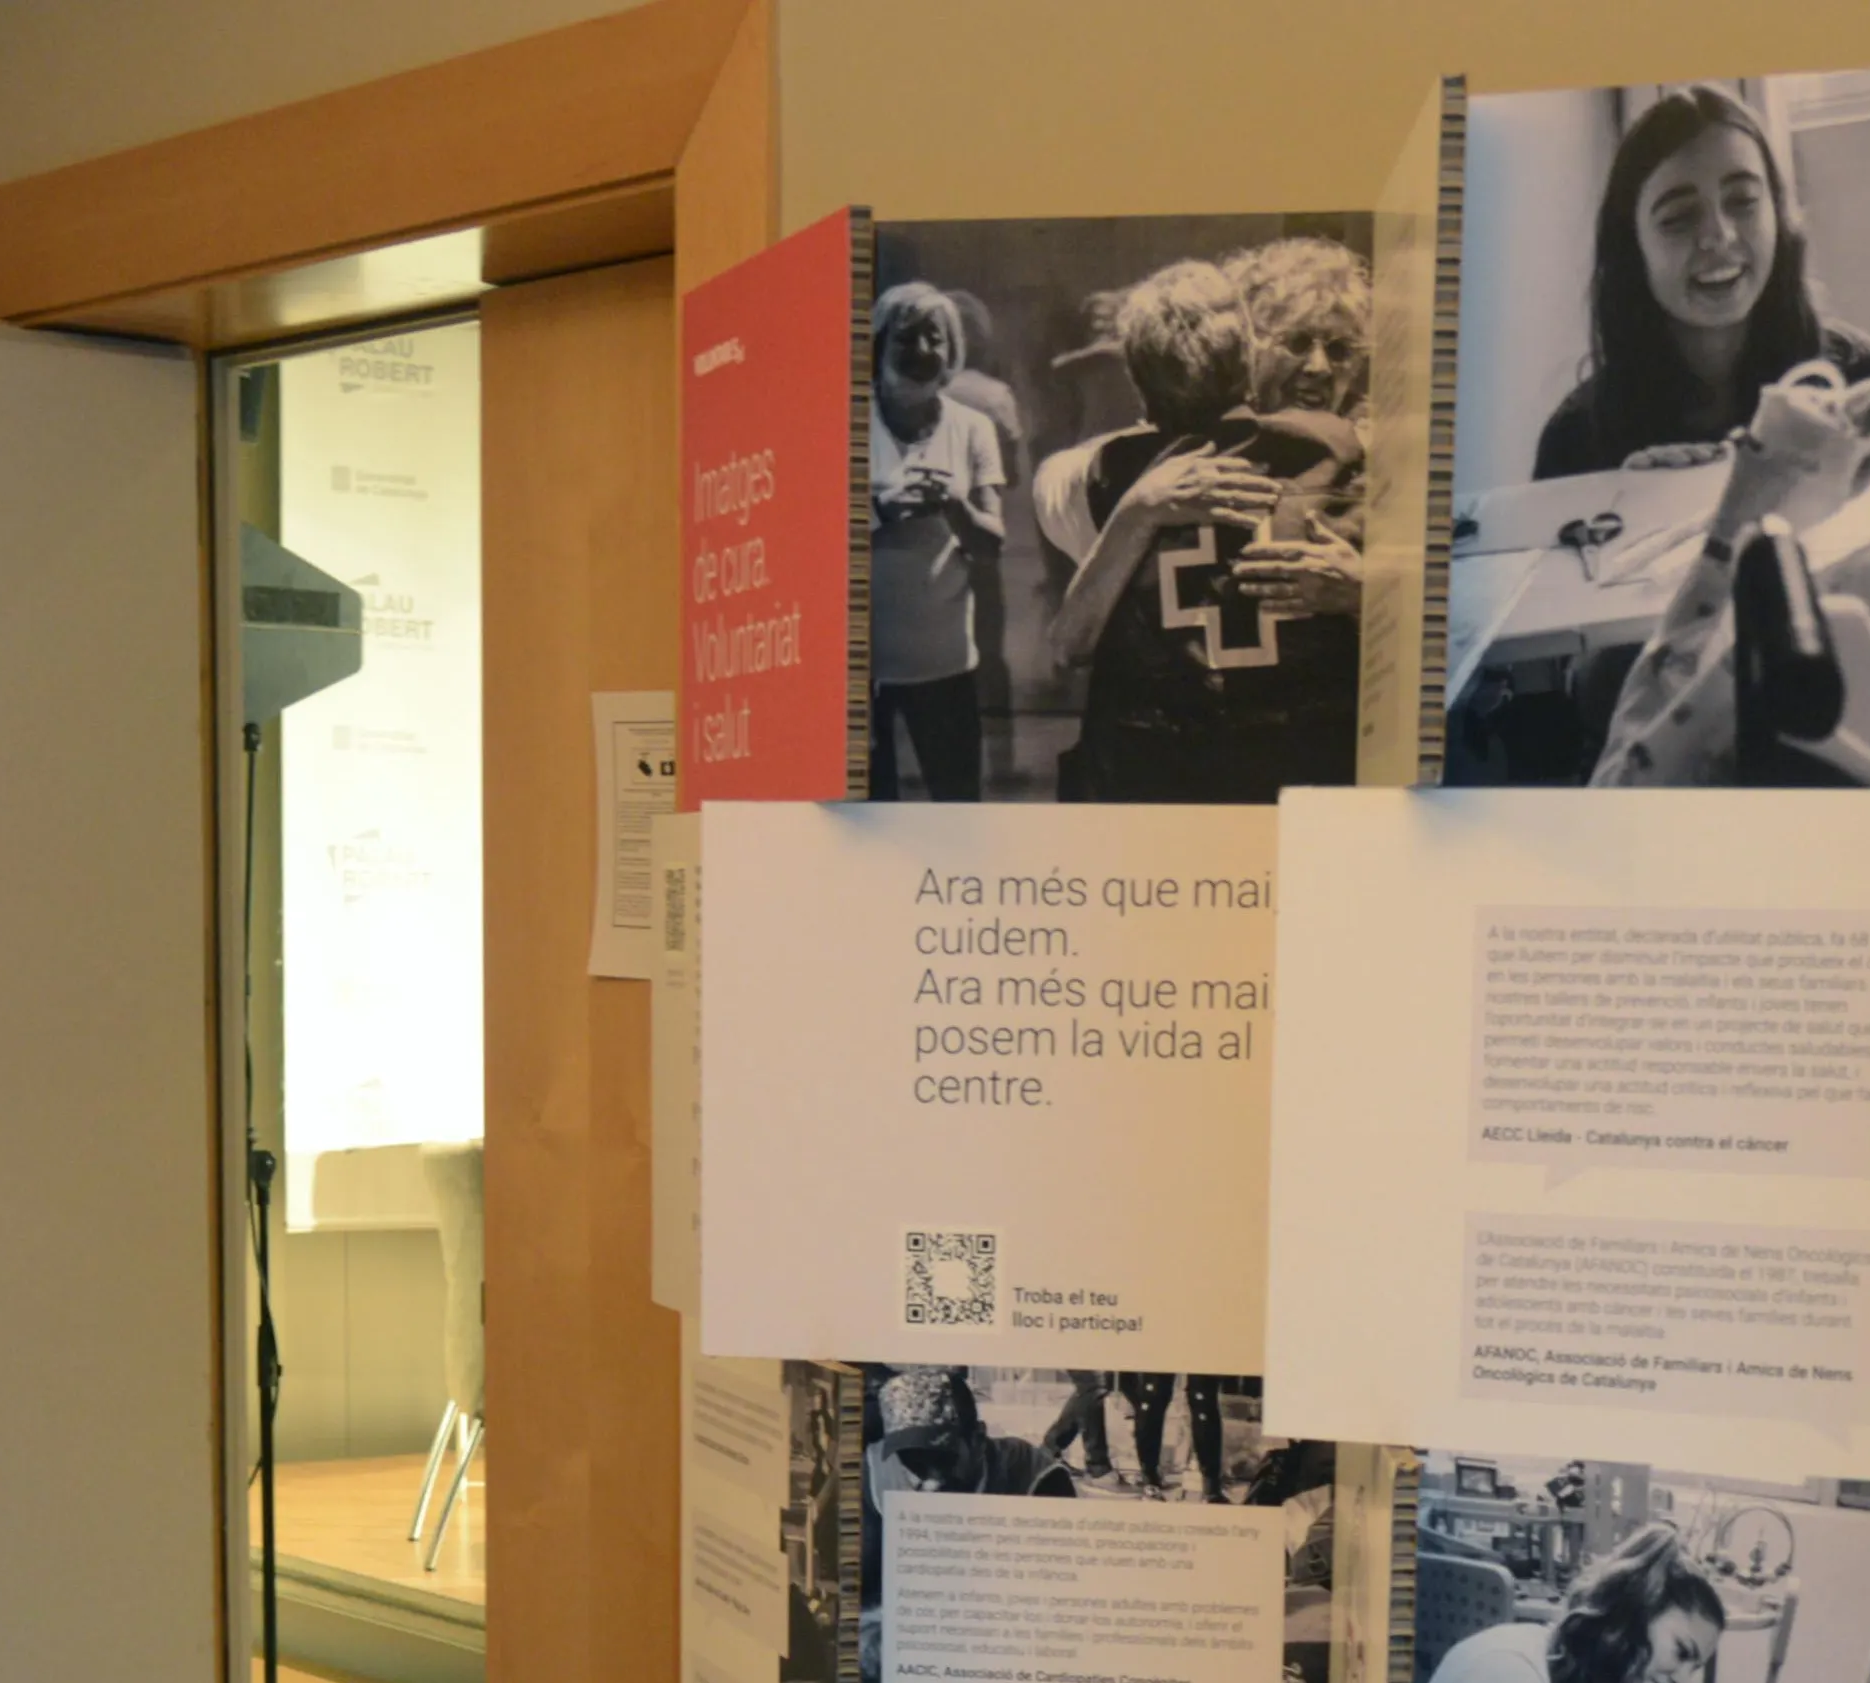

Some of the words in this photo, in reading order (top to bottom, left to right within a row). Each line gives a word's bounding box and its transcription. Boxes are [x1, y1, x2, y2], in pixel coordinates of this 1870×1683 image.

[338, 355, 435, 386] ROBERT
[693, 447, 775, 526] Imatges
[693, 537, 717, 604] de
[721, 536, 772, 598] cura.
[693, 600, 801, 684] Voluntariat
[703, 692, 751, 763] salut
[914, 866, 983, 905] Ara
[998, 866, 1087, 907] més
[1101, 877, 1179, 917] que
[914, 917, 1079, 956] cuidem.
[914, 967, 982, 1005] Ara
[997, 967, 1086, 1007] més
[1100, 978, 1177, 1017] que
[914, 1024, 1056, 1063] posem
[1071, 1017, 1104, 1058] la
[1118, 1019, 1202, 1059] vida
[1217, 1020, 1253, 1060] al
[913, 1072, 1053, 1106] centre.
[1012, 1286, 1063, 1305] Troba
[1068, 1288, 1084, 1305] el
[1088, 1291, 1119, 1306] teu
[1011, 1310, 1044, 1328] lloc
[1058, 1315, 1144, 1334] participa!
